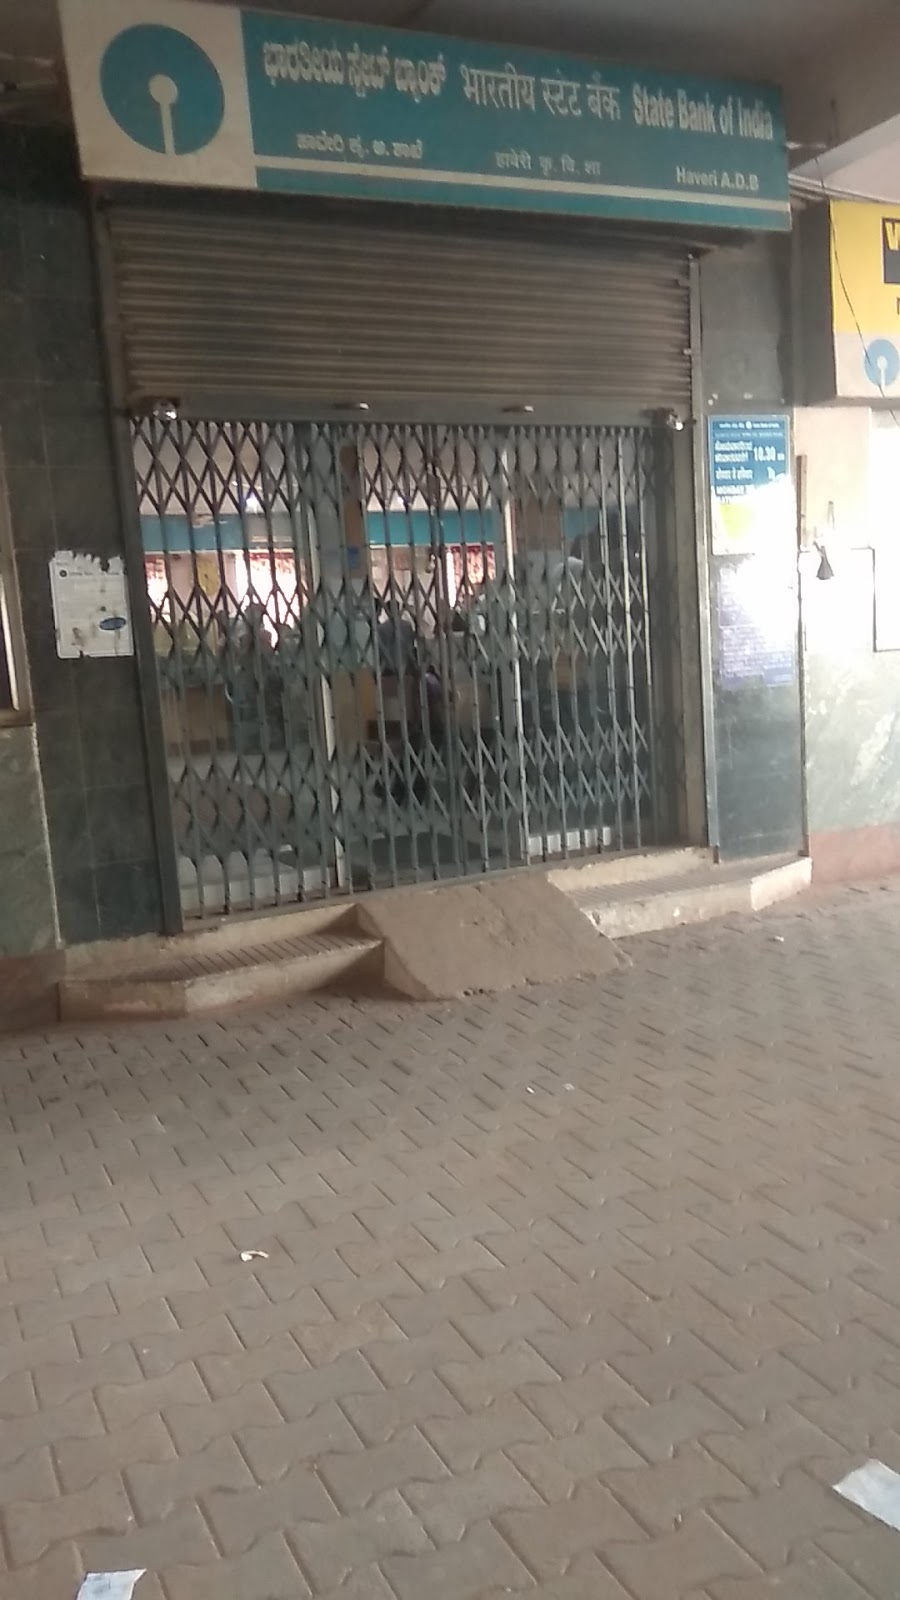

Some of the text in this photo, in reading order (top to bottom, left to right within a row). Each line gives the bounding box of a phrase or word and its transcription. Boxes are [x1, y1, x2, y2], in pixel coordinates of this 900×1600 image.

[460, 62, 535, 112] भारतीय
[541, 68, 582, 116] स्टेट
[632, 83, 773, 140] State Bank of India
[676, 165, 717, 186] Haveri
